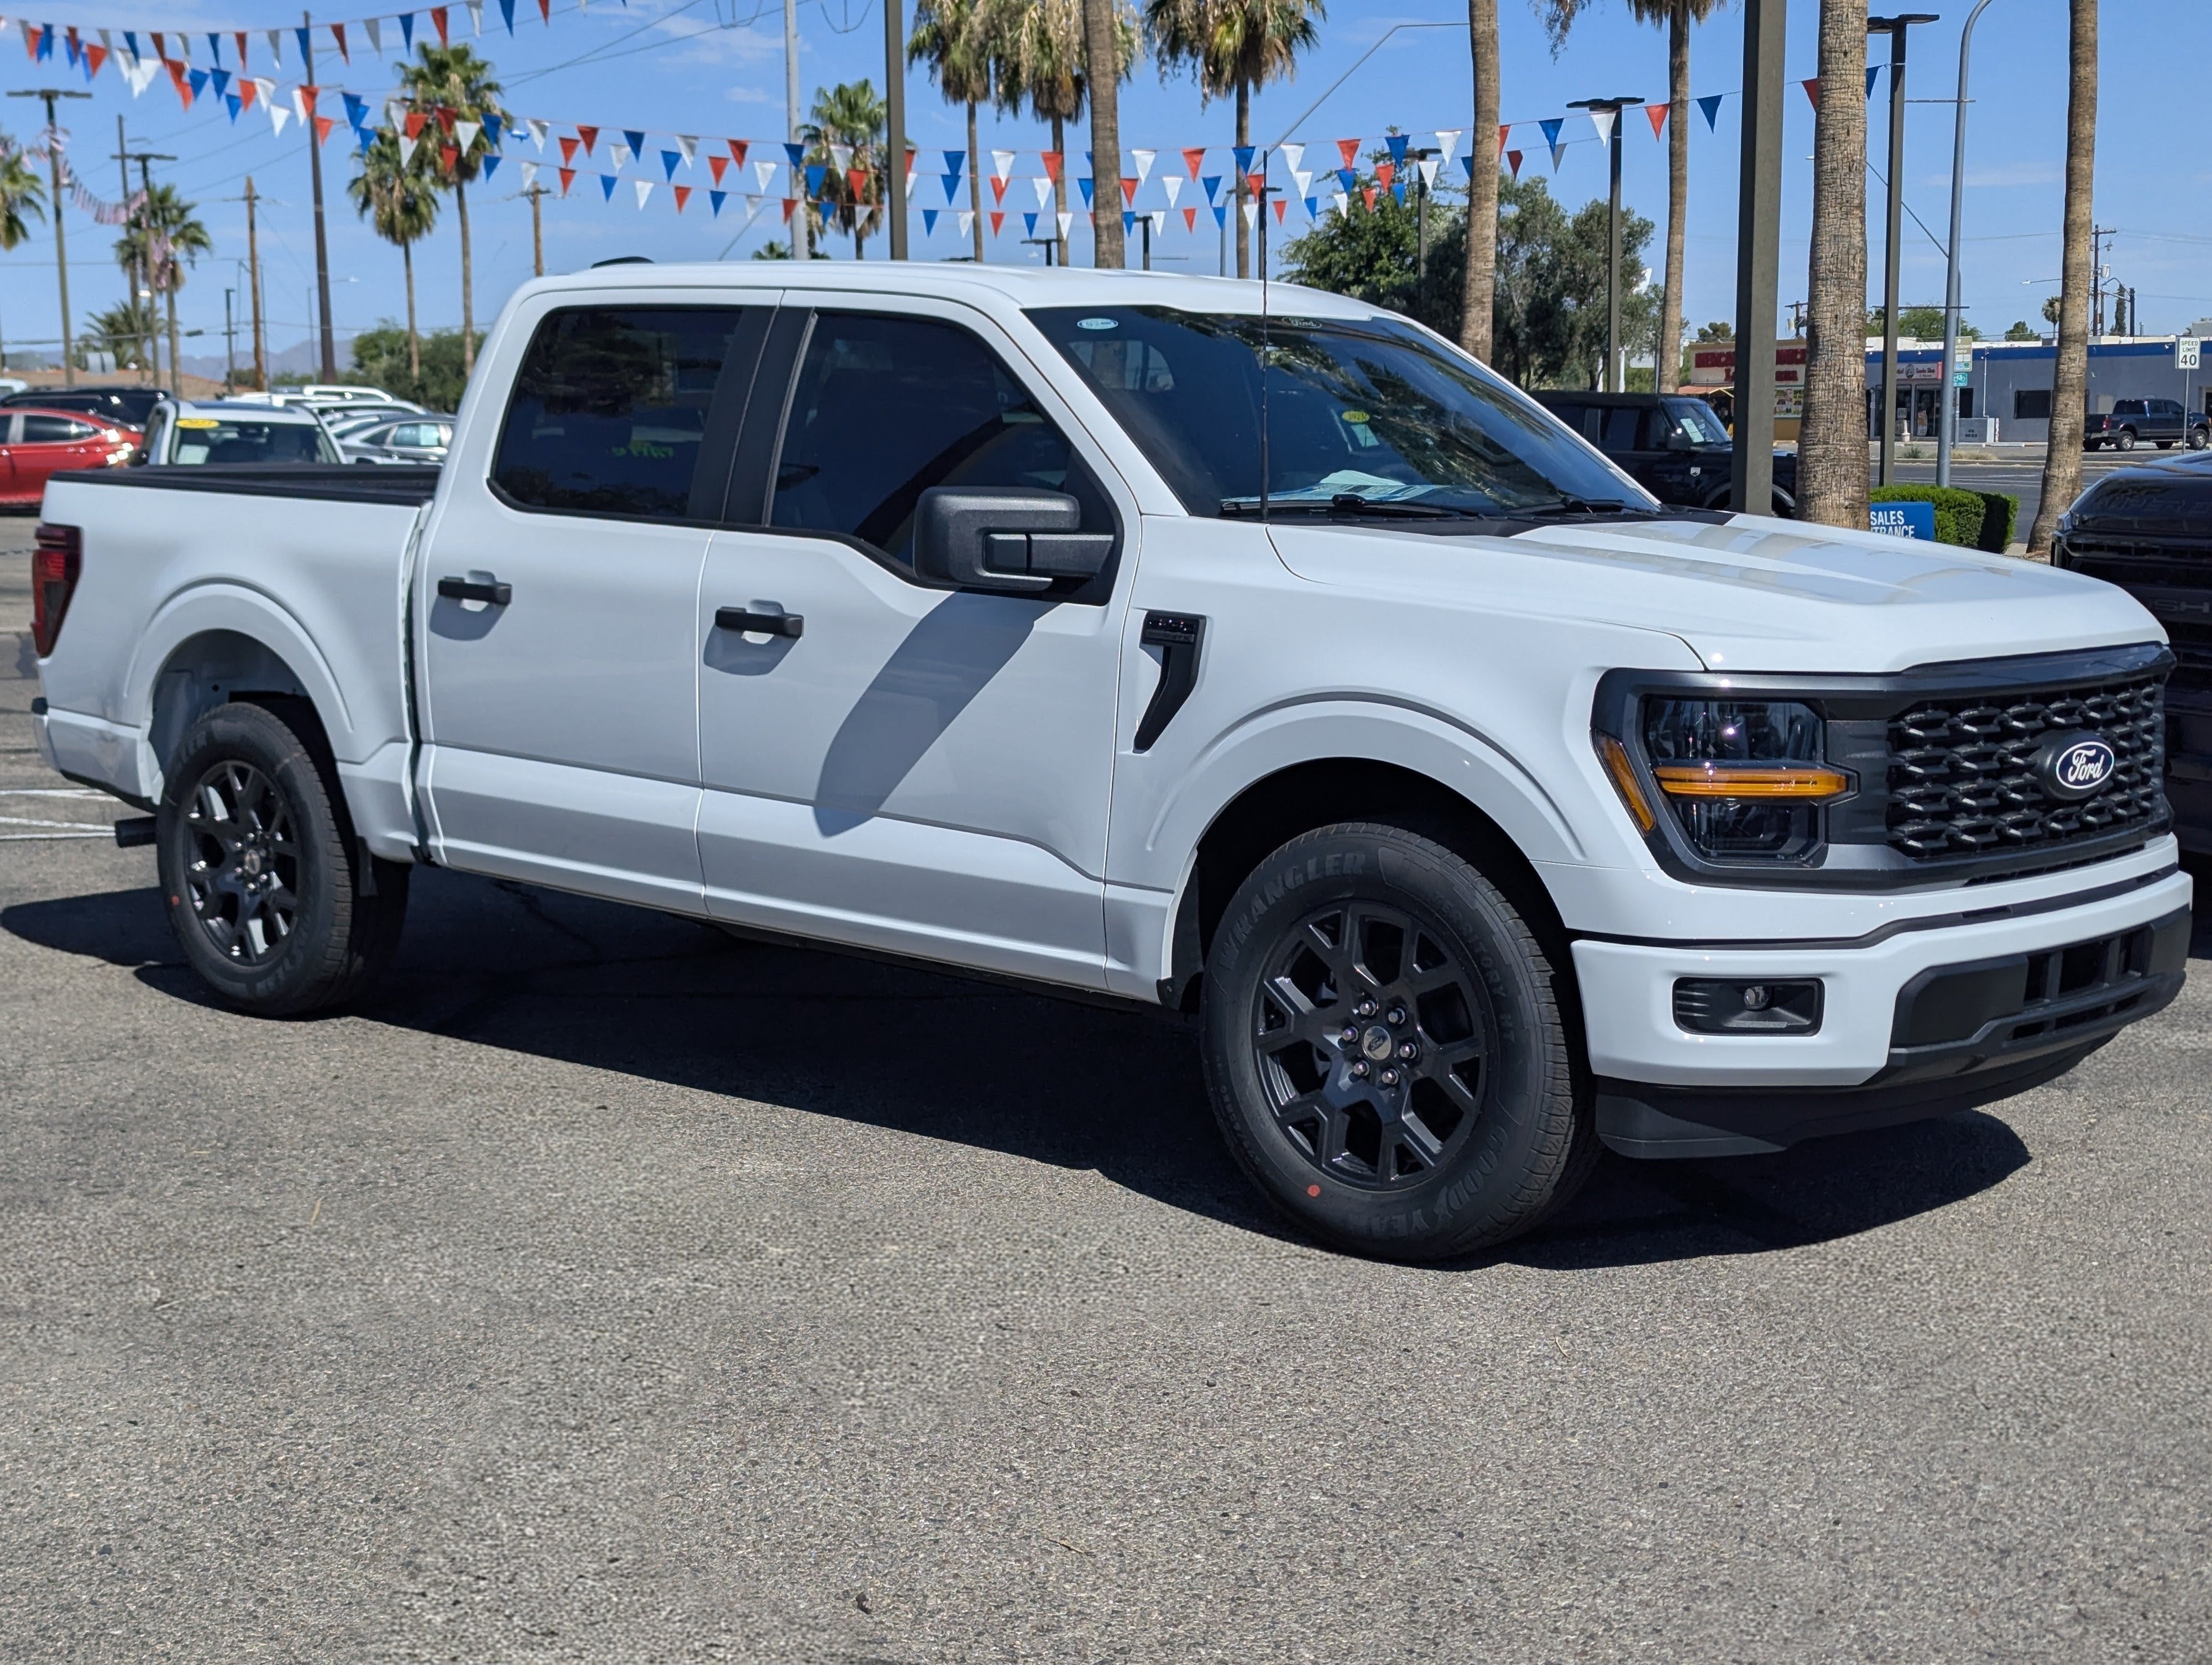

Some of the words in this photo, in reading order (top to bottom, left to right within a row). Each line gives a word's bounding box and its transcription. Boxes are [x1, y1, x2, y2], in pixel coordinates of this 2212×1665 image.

[2180, 354, 2197, 365] 40
[1870, 510, 1905, 526] SALES
[2068, 748, 2105, 782] Ford
[1218, 852, 1366, 970] WRANGLER
